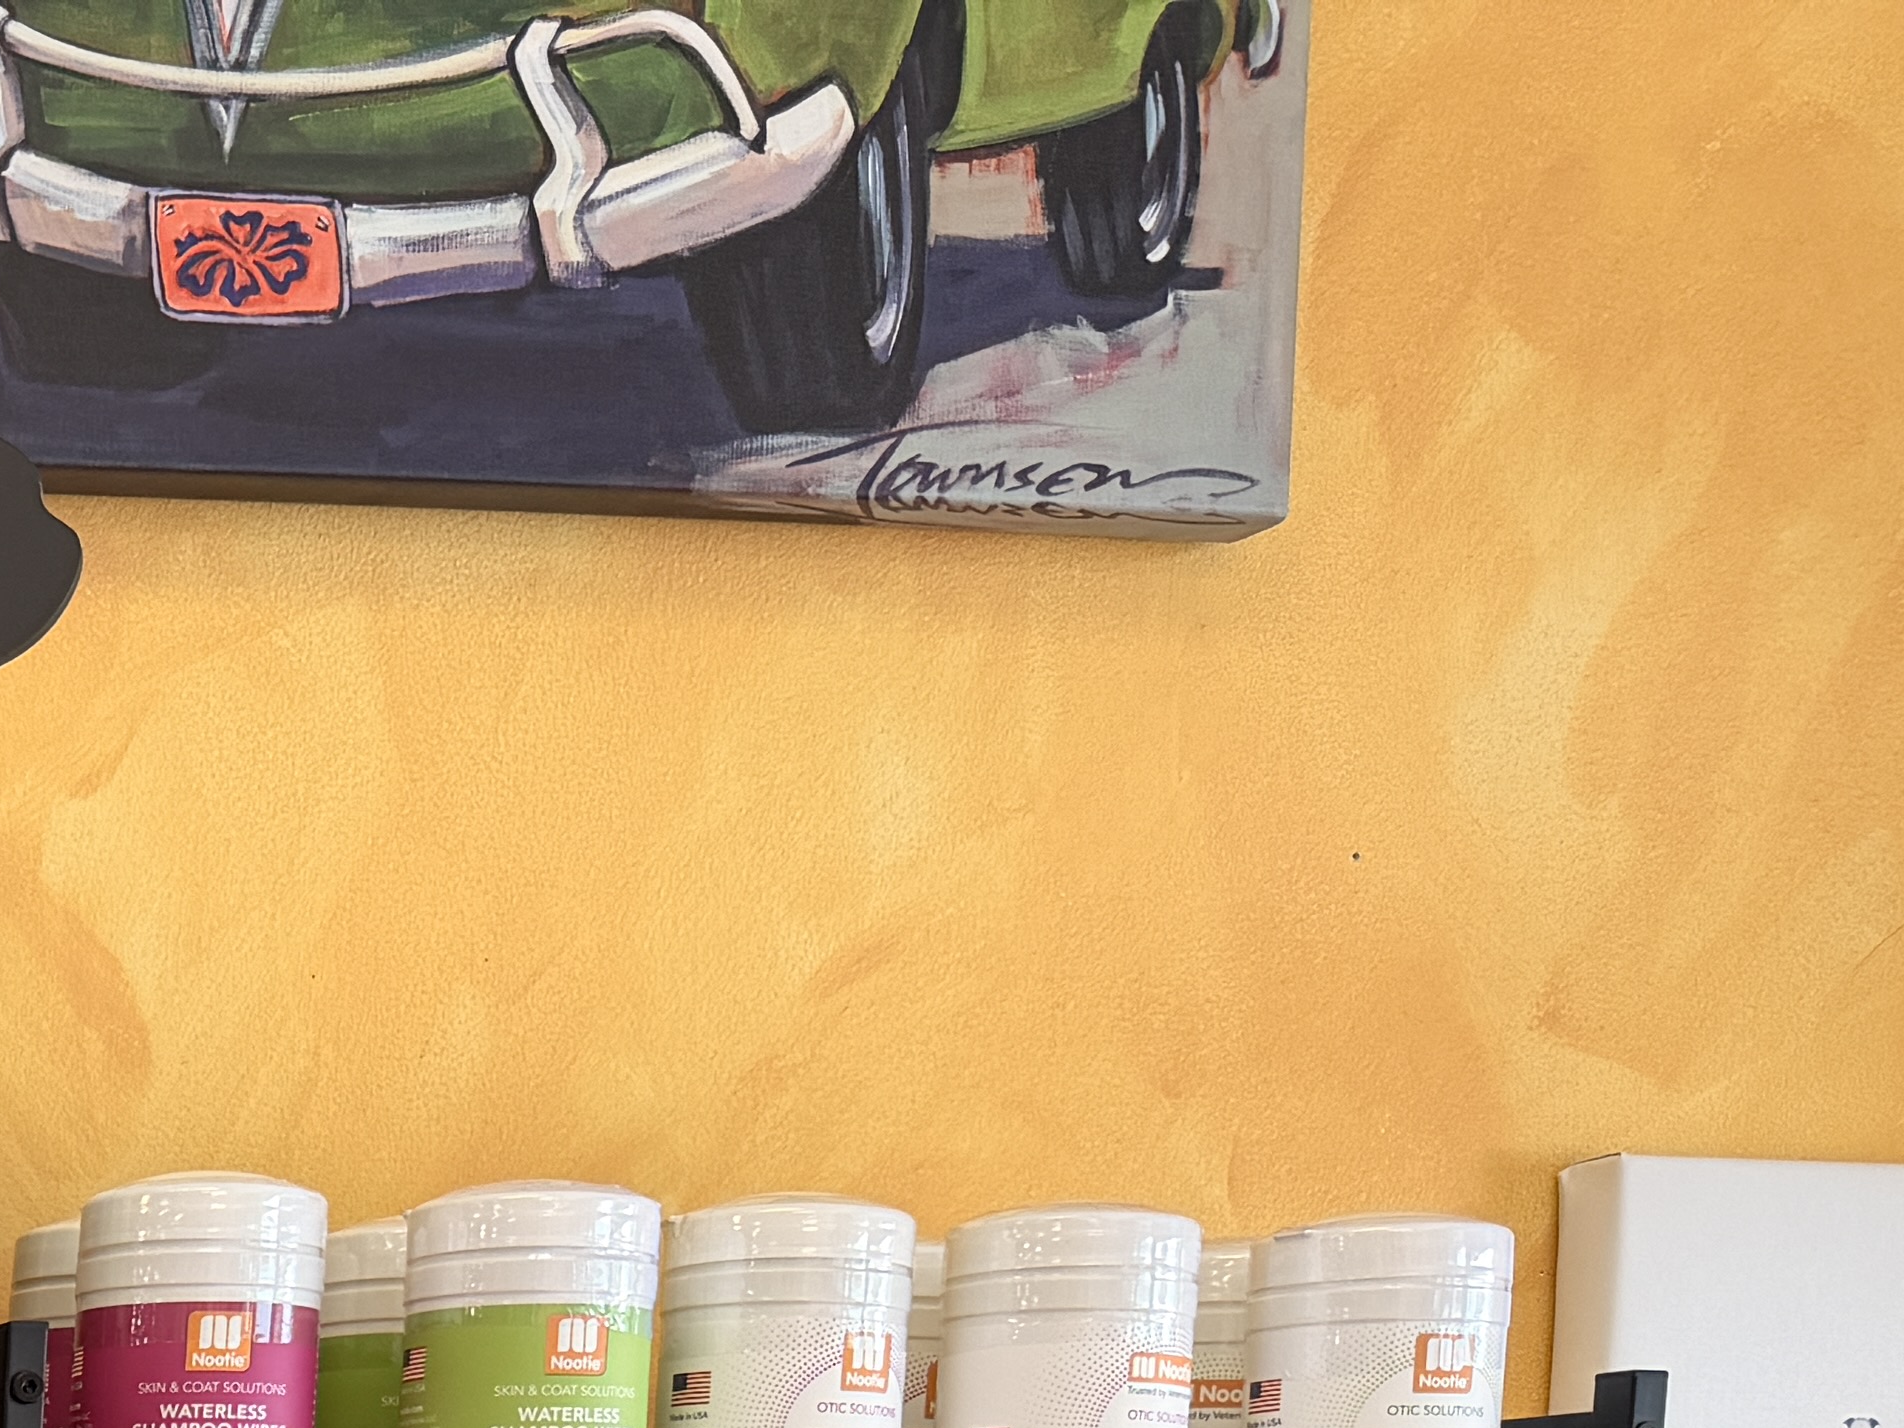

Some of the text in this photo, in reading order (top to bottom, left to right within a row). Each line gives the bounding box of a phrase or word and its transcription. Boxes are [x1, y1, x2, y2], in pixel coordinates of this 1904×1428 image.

[193, 1352, 246, 1370] Nootie
[160, 1404, 266, 1422] WATERLESS
[518, 1407, 620, 1424] WATERLESS
[1387, 1405, 1484, 1417] OTIC SOLUTIONS
